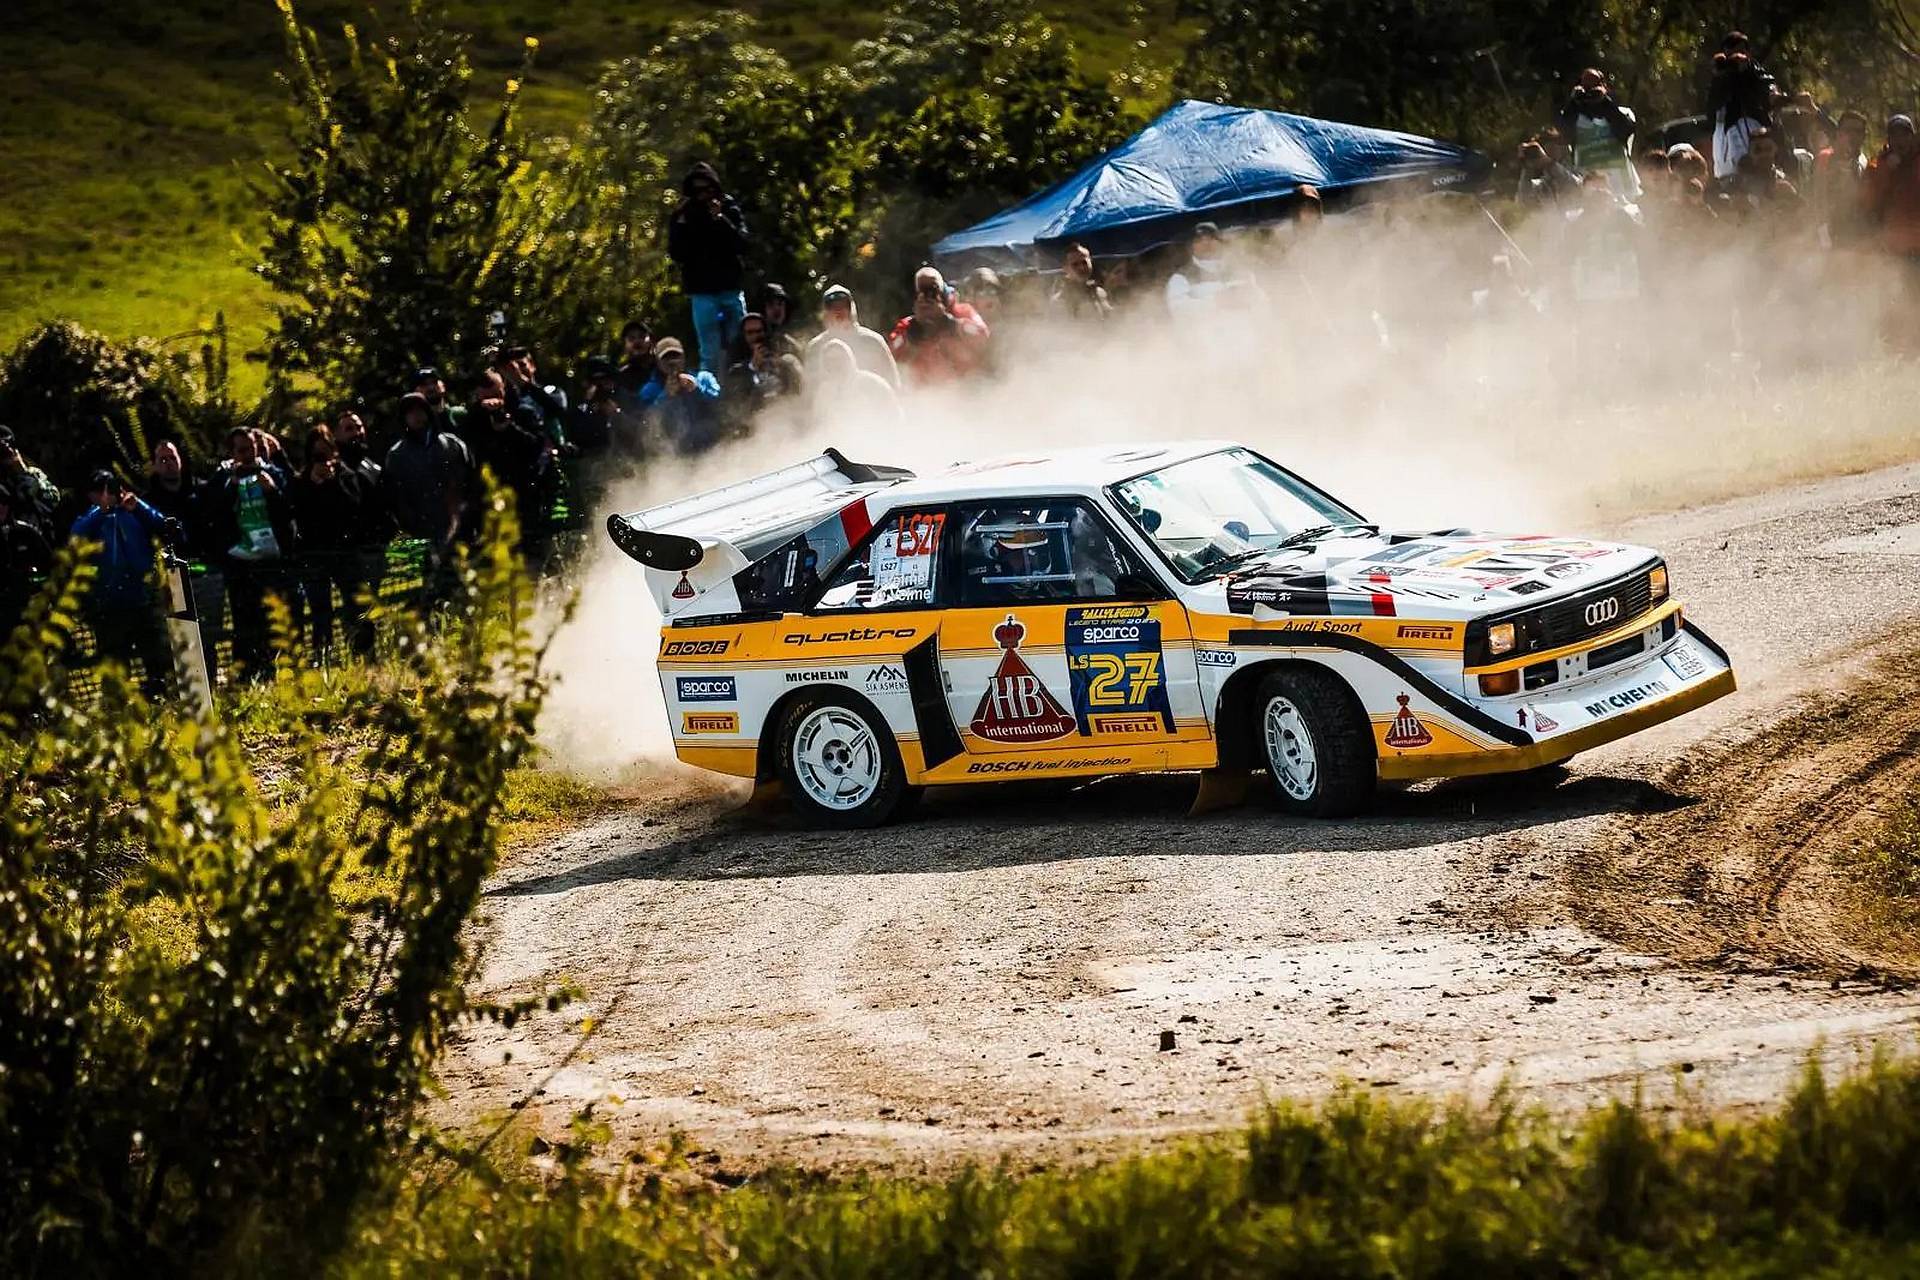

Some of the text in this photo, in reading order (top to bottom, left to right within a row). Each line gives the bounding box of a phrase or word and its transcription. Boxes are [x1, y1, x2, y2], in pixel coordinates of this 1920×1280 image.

[895, 512, 947, 557] LS27
[880, 562, 898, 571] LS27
[1083, 626, 1139, 643] sparco
[1283, 621, 1362, 633] Audi Sport
[1397, 625, 1454, 640] PIRELLI
[784, 628, 916, 646] quattro
[667, 642, 727, 655] BOGE
[785, 671, 849, 682] MICHELIN
[1069, 652, 1160, 706] LS 27
[683, 682, 730, 696] sparco
[989, 675, 1044, 719] HB
[1584, 681, 1670, 718] MICHELIN
[687, 716, 735, 730] PIRELLI
[984, 721, 1065, 737] international
[1095, 716, 1159, 733] PIRELLI
[1394, 716, 1419, 737] HB
[967, 756, 1132, 773] BOSCH fuel injection
